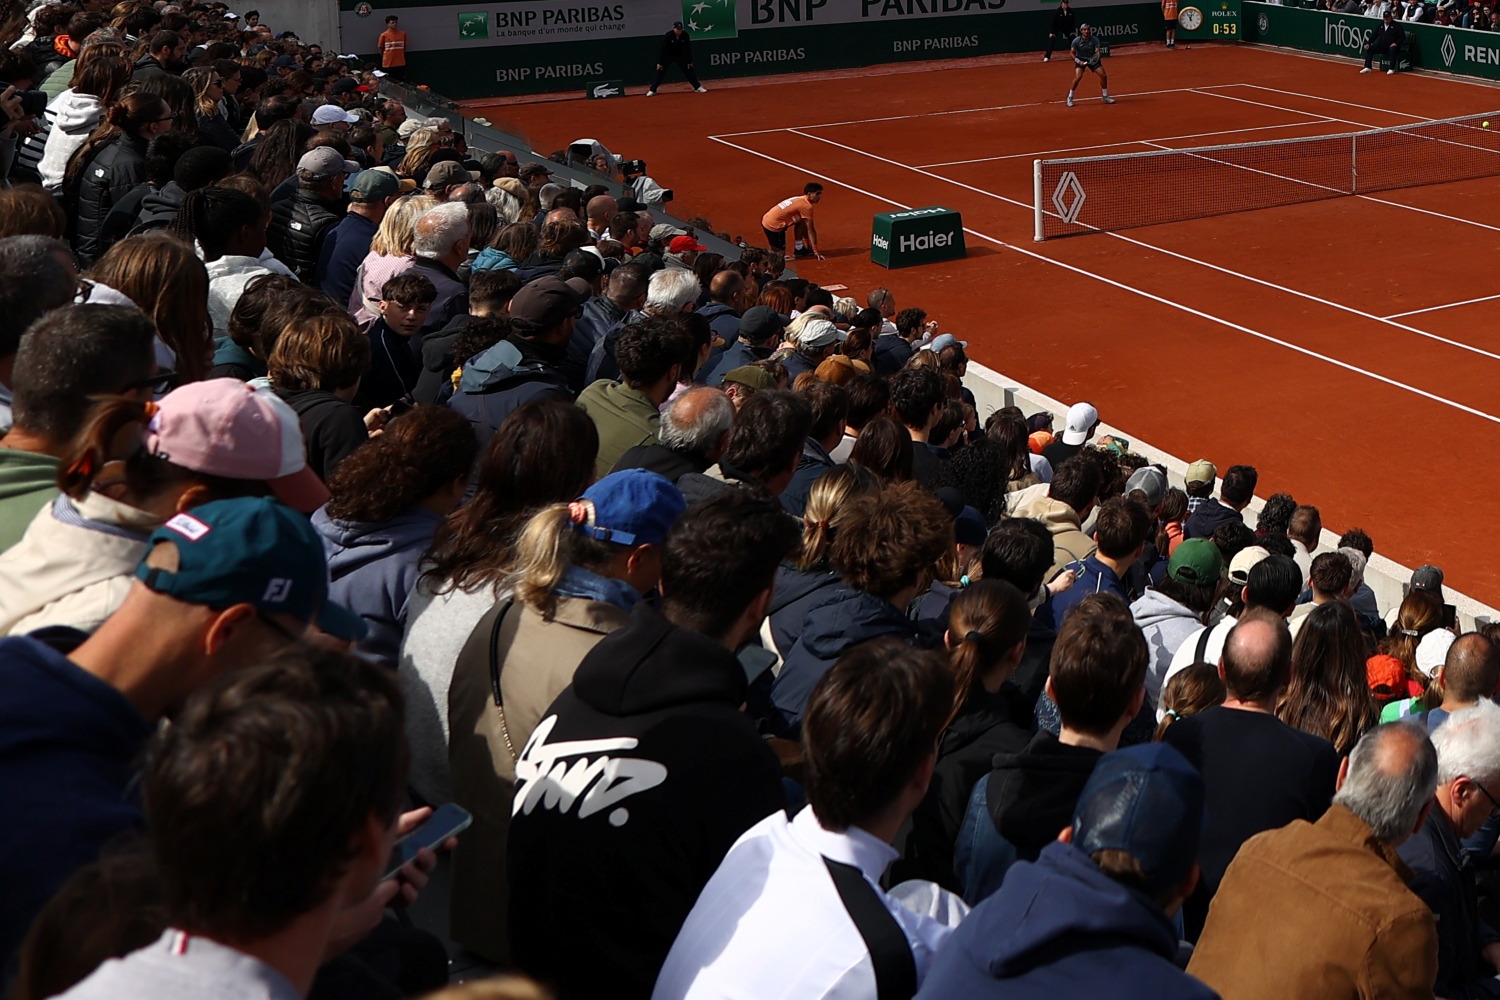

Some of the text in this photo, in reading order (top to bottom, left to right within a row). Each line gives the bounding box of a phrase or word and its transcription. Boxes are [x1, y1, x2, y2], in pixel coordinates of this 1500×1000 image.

[496, 5, 624, 28] BNP PARIBAS
[496, 22, 626, 38] La banque d'un monde qui change
[1091, 23, 1138, 37] PARIBAS
[1212, 23, 1237, 35] 0:53
[893, 35, 979, 52] BNP PARIBAS
[710, 48, 806, 66] BNP PARIBAS
[496, 62, 604, 82] BNP PARIBAS
[890, 207, 947, 219] Haier
[872, 233, 889, 250] Haier
[900, 230, 954, 253] Haier
